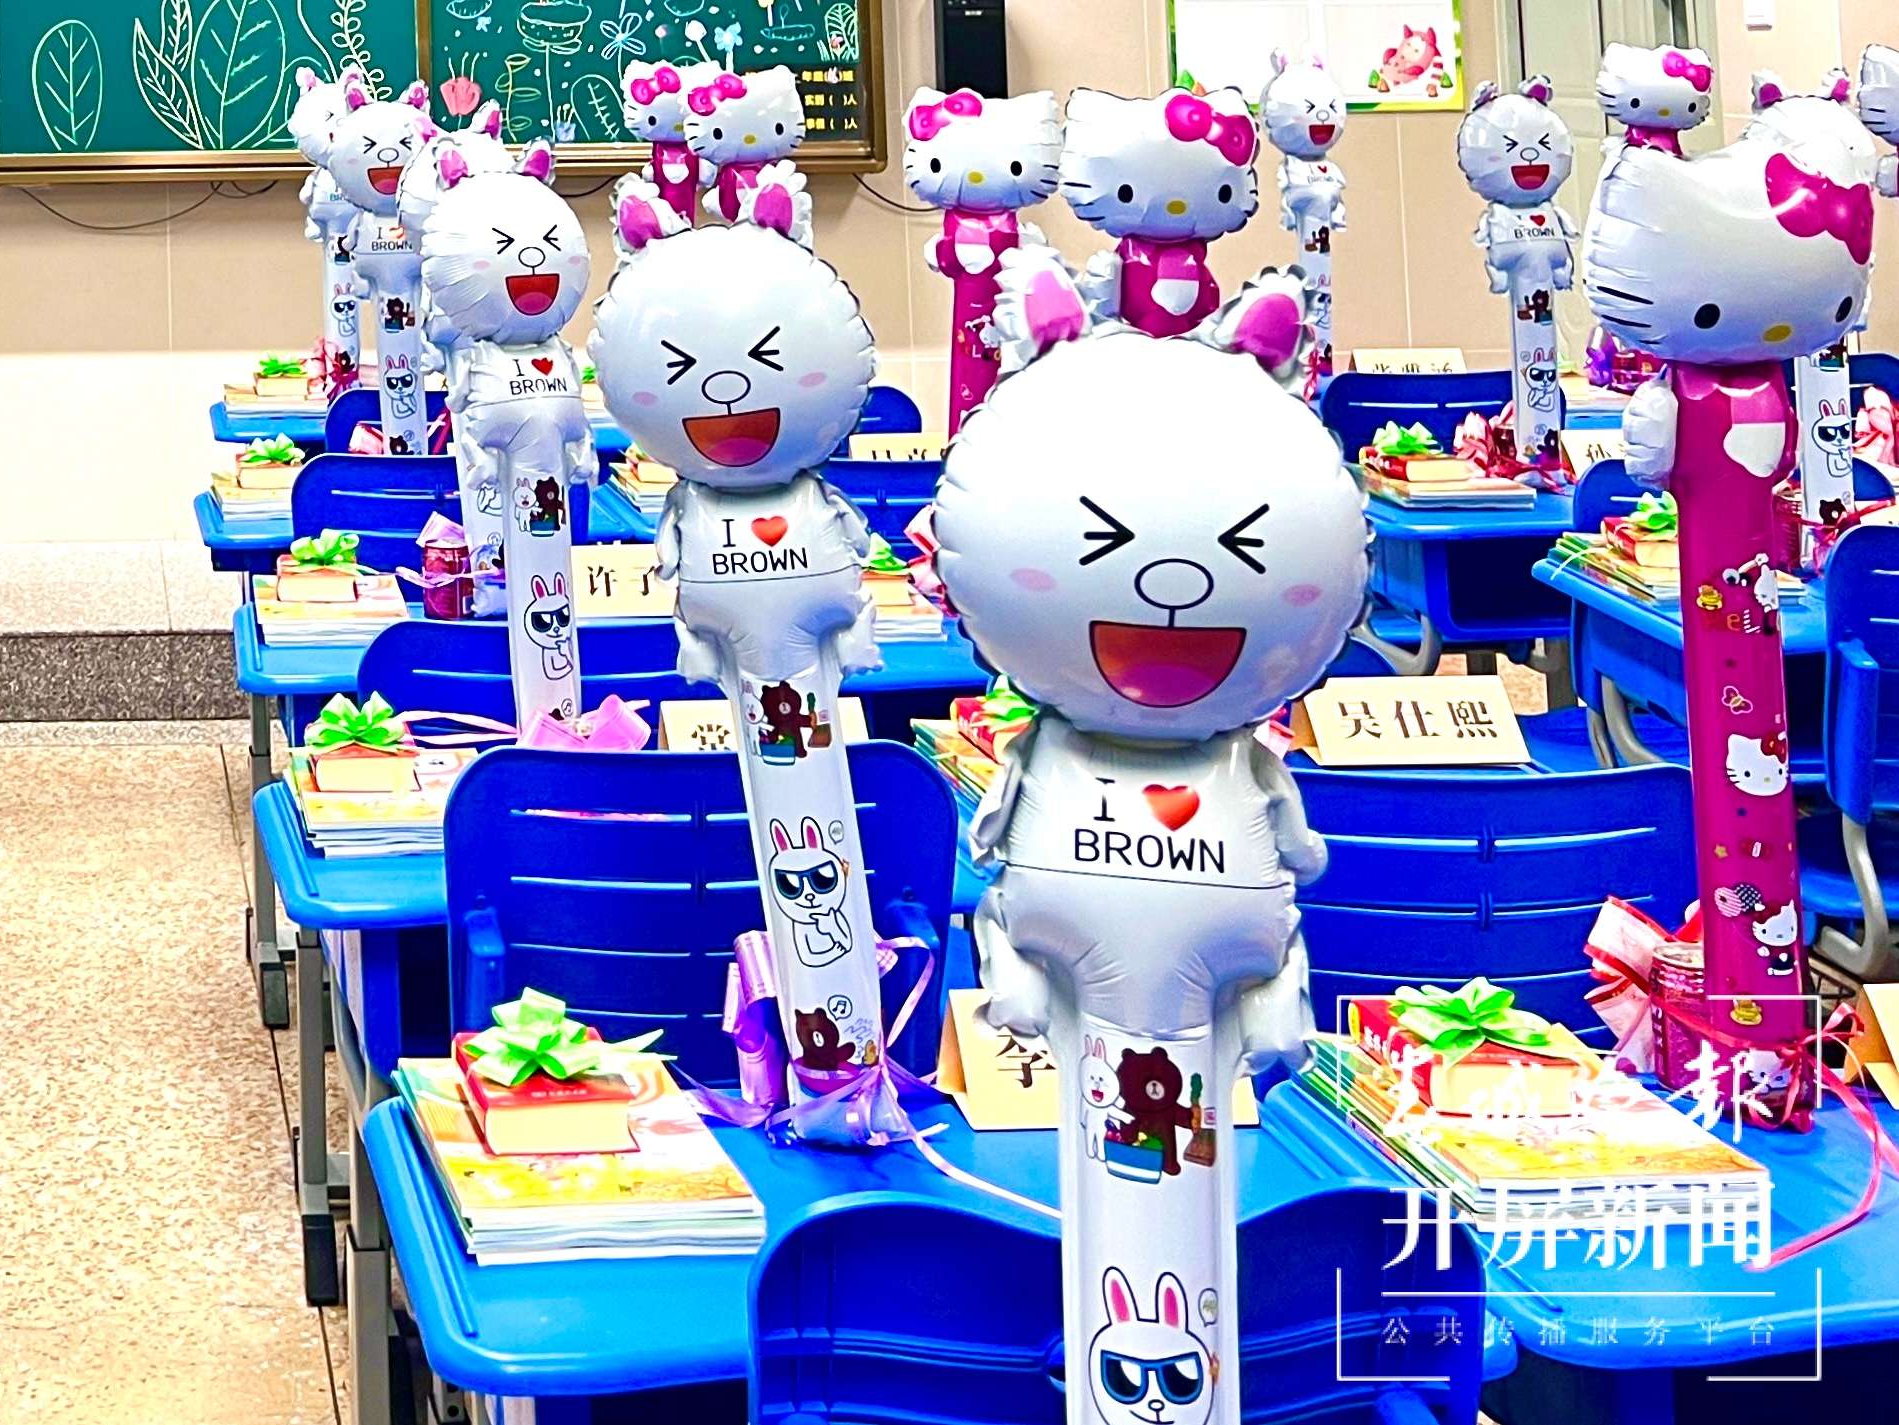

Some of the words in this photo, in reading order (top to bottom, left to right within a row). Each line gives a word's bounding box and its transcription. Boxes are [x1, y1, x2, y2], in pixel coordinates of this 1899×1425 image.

[371, 241, 413, 251] BROWN
[512, 359, 525, 377] I
[509, 377, 567, 395] BROWN
[722, 519, 736, 548] I
[712, 548, 808, 575] BROWN
[1338, 700, 1498, 739] 吴仕熙
[1095, 779, 1115, 822] I
[1074, 828, 1225, 873] BROWN
